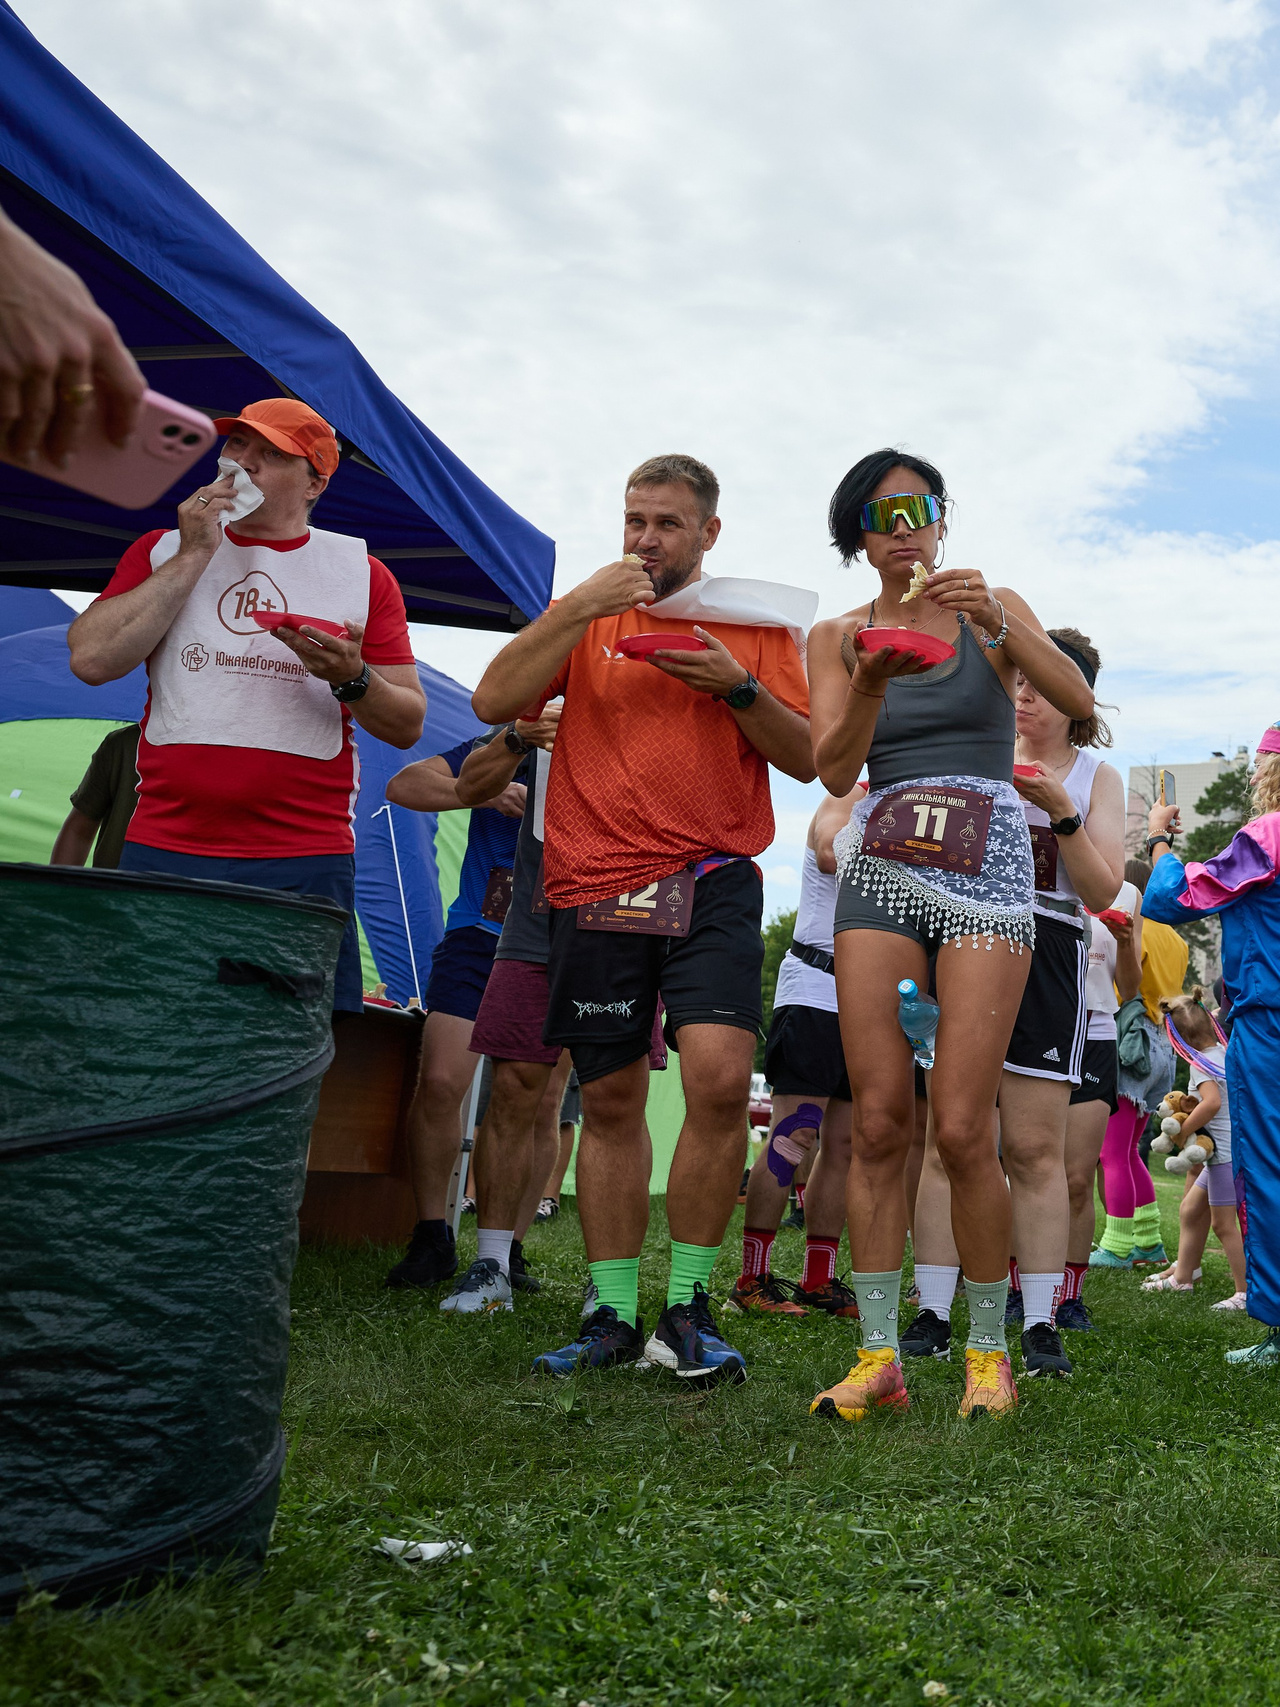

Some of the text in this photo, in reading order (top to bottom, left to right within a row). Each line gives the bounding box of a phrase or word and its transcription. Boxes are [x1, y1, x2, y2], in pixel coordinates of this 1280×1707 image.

[234, 587, 277, 620] 18+
[901, 793, 967, 809] ХИНКАЛЬНАЯ МИЛЯ
[913, 804, 949, 842] 11
[1084, 1071, 1100, 1084] Run
